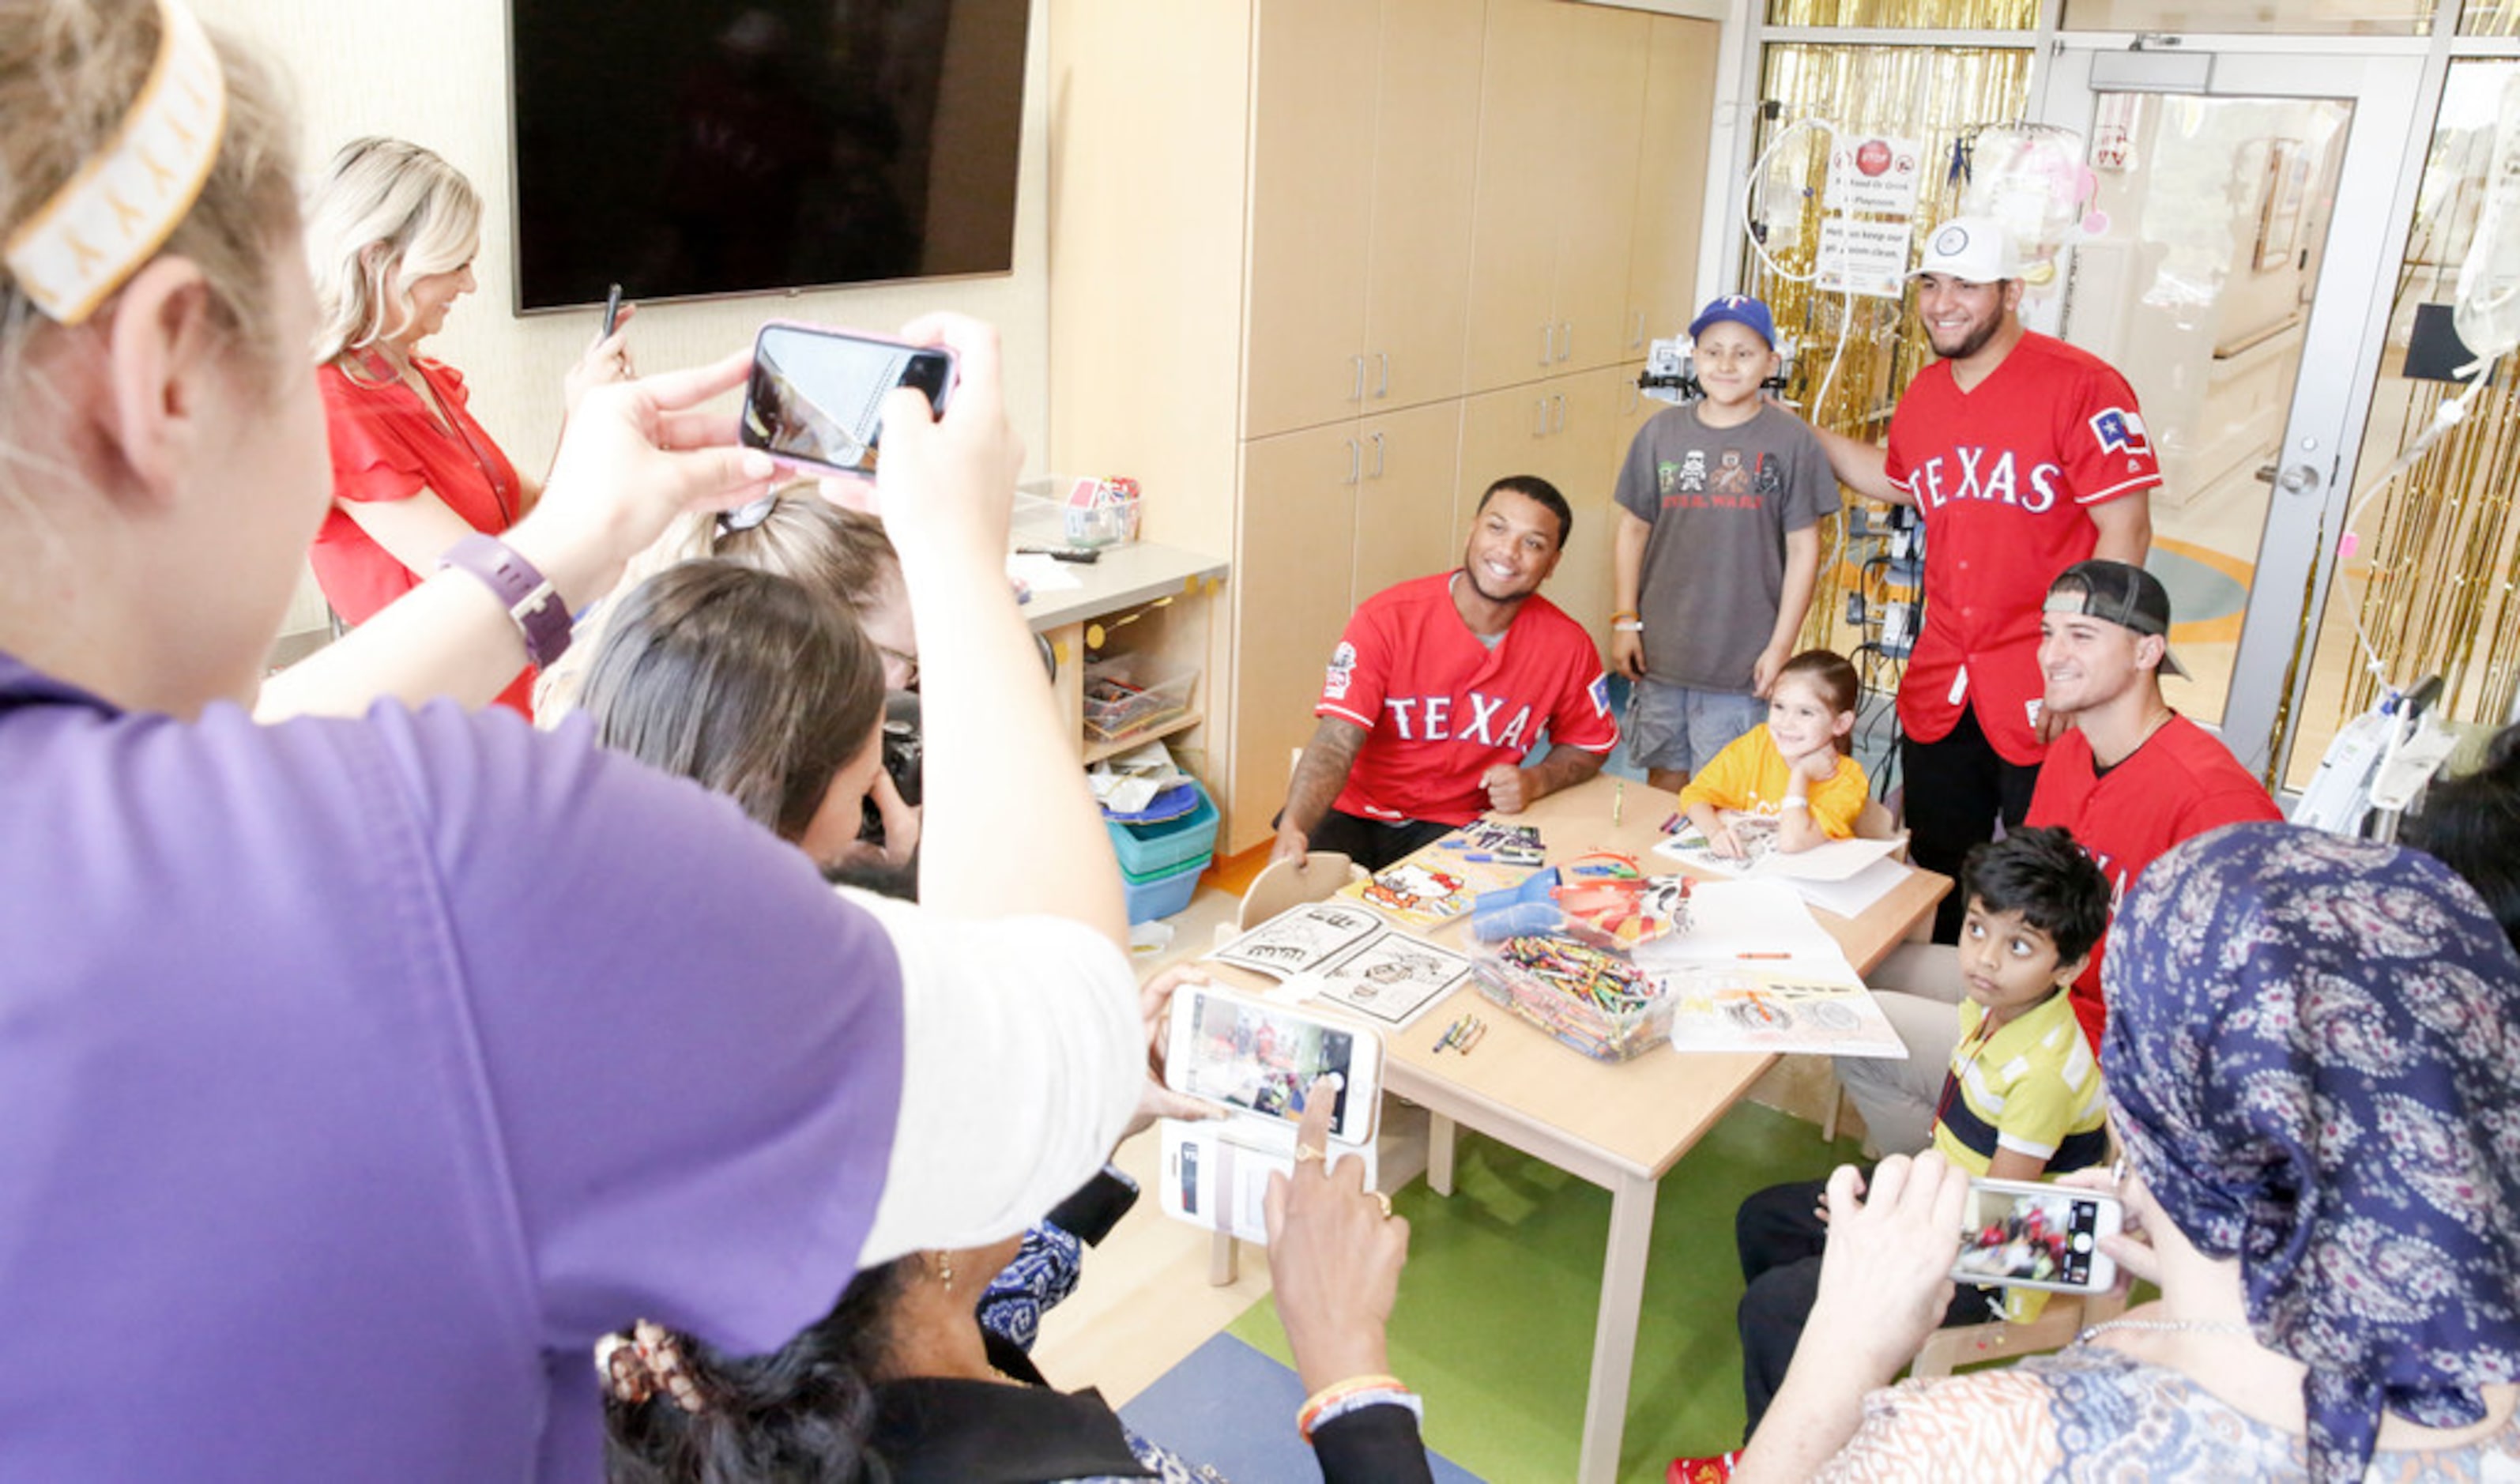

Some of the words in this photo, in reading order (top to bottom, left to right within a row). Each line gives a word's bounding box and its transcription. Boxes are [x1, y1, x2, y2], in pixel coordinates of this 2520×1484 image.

[1863, 230, 1885, 242] keep
[1721, 294, 1750, 310] T
[1907, 445, 2064, 516] TEXAS
